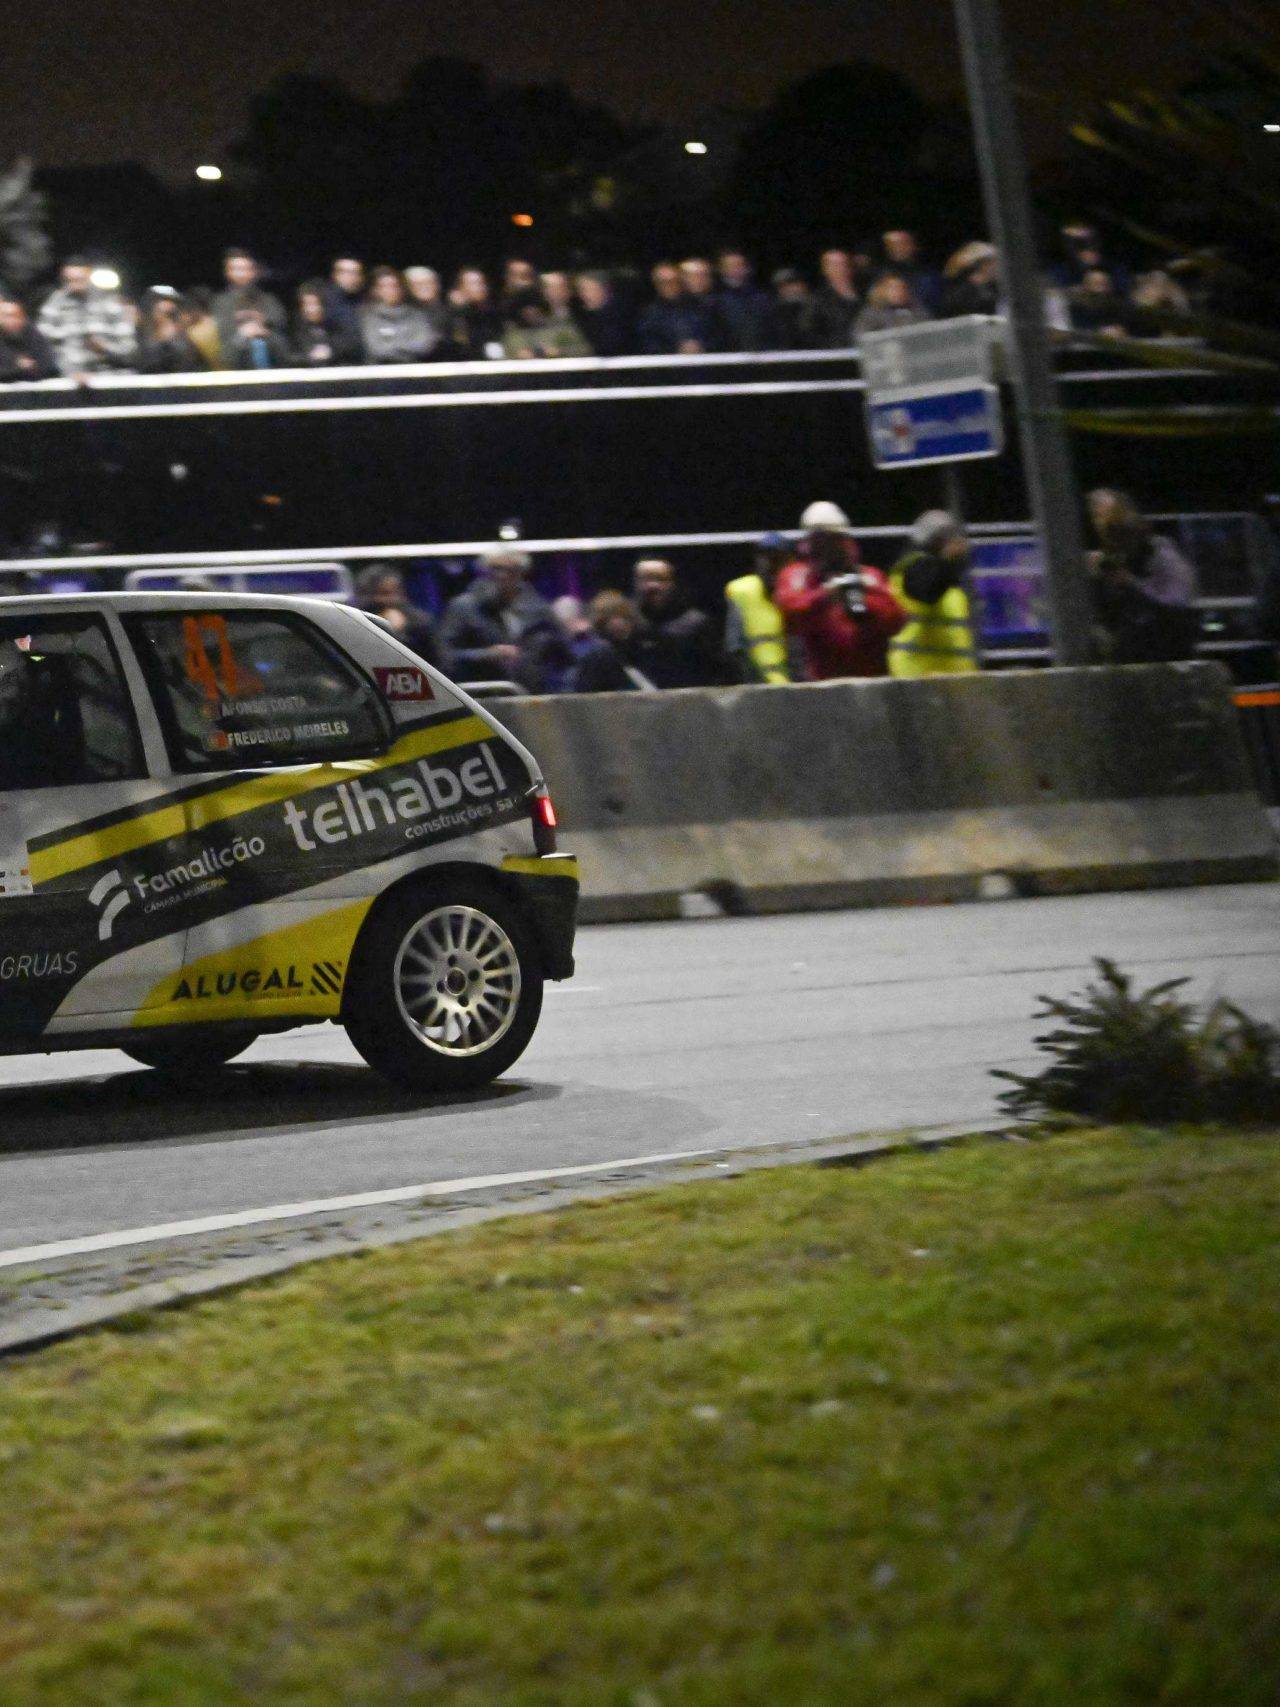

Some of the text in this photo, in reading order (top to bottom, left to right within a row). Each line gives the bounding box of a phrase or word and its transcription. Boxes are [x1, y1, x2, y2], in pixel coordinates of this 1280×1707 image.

[226, 726, 291, 746] FREDERICO
[283, 742, 507, 850] telhabel
[405, 801, 493, 840] construções
[133, 836, 265, 899] Famalicão
[171, 965, 304, 1001] ALUGAL
